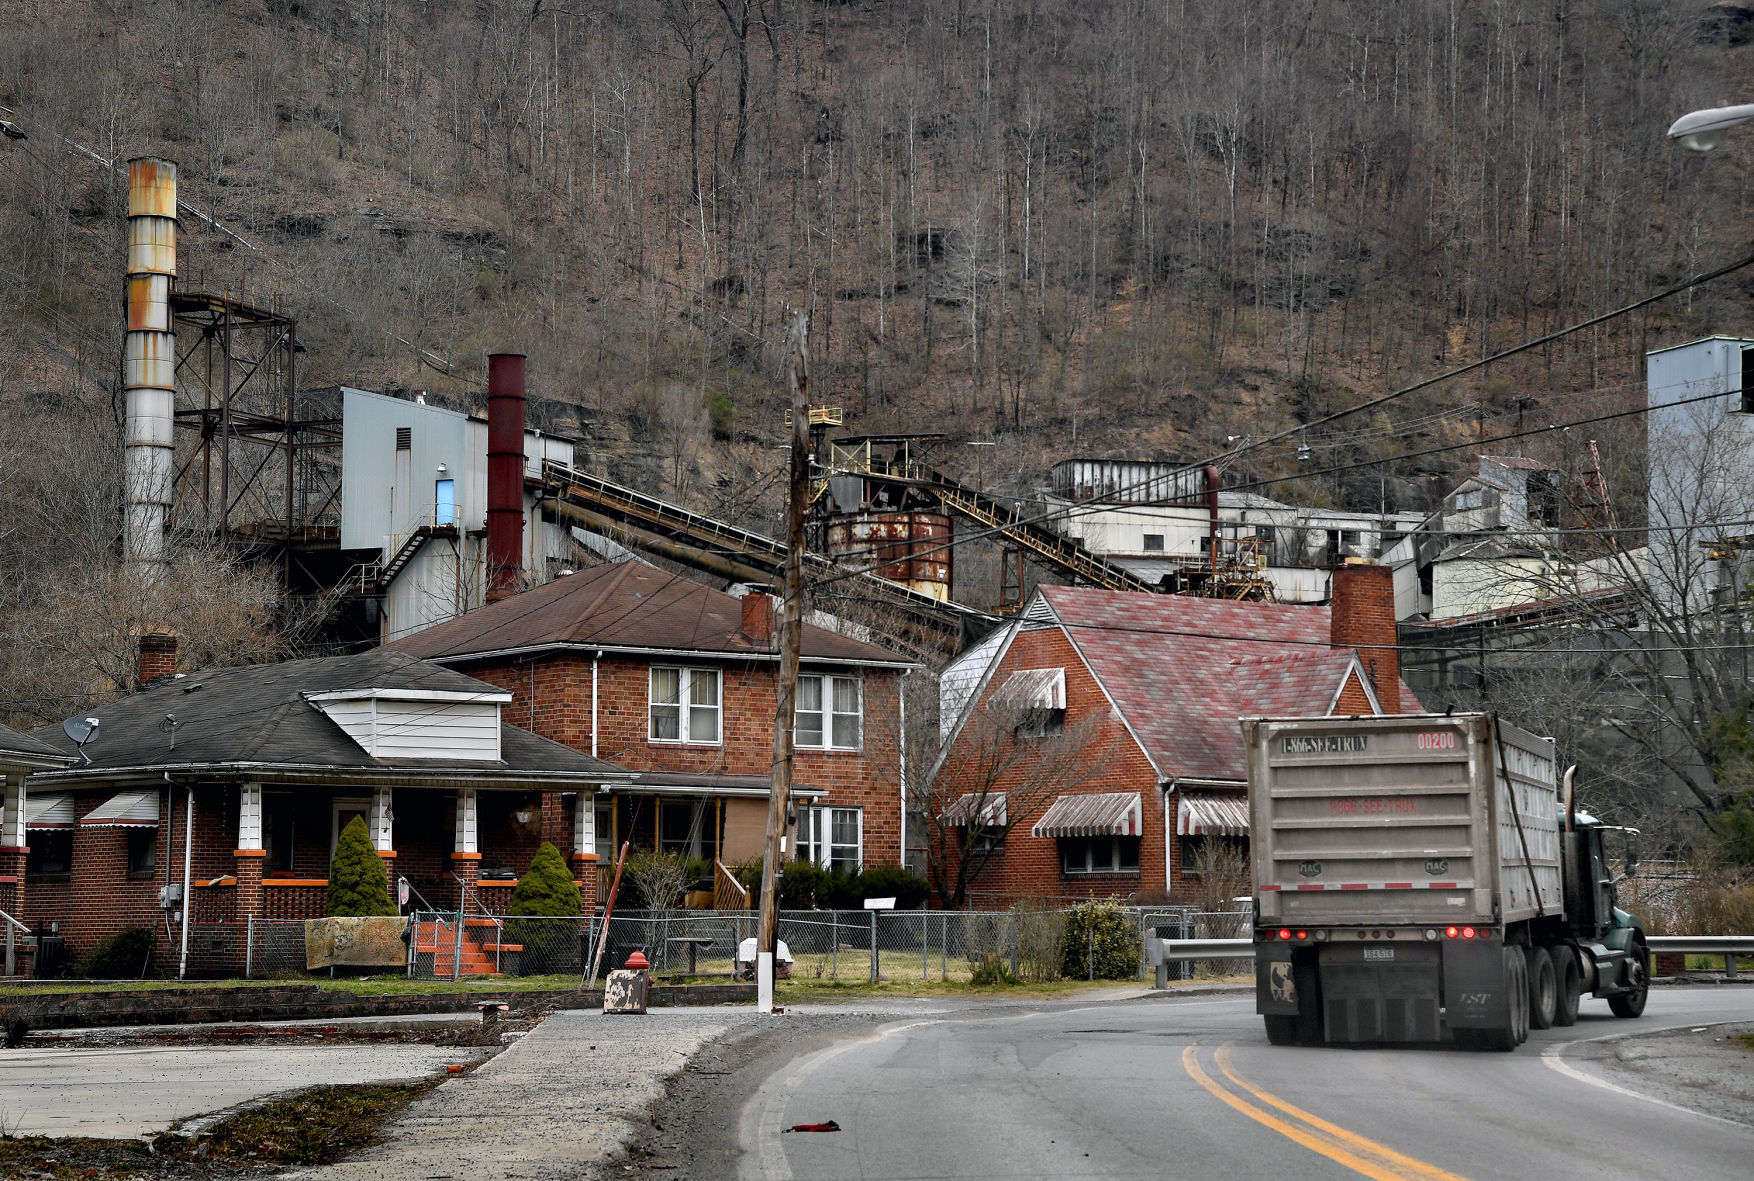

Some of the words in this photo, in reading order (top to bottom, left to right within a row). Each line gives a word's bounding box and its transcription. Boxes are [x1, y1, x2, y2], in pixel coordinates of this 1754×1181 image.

[1282, 736, 1368, 754] 1-866-SEE-TRUX
[1417, 732, 1455, 750] 00200
[1329, 798, 1417, 815] 1-866-SEE-TRUX
[1299, 863, 1320, 874] MAC
[1426, 861, 1447, 872] MAC
